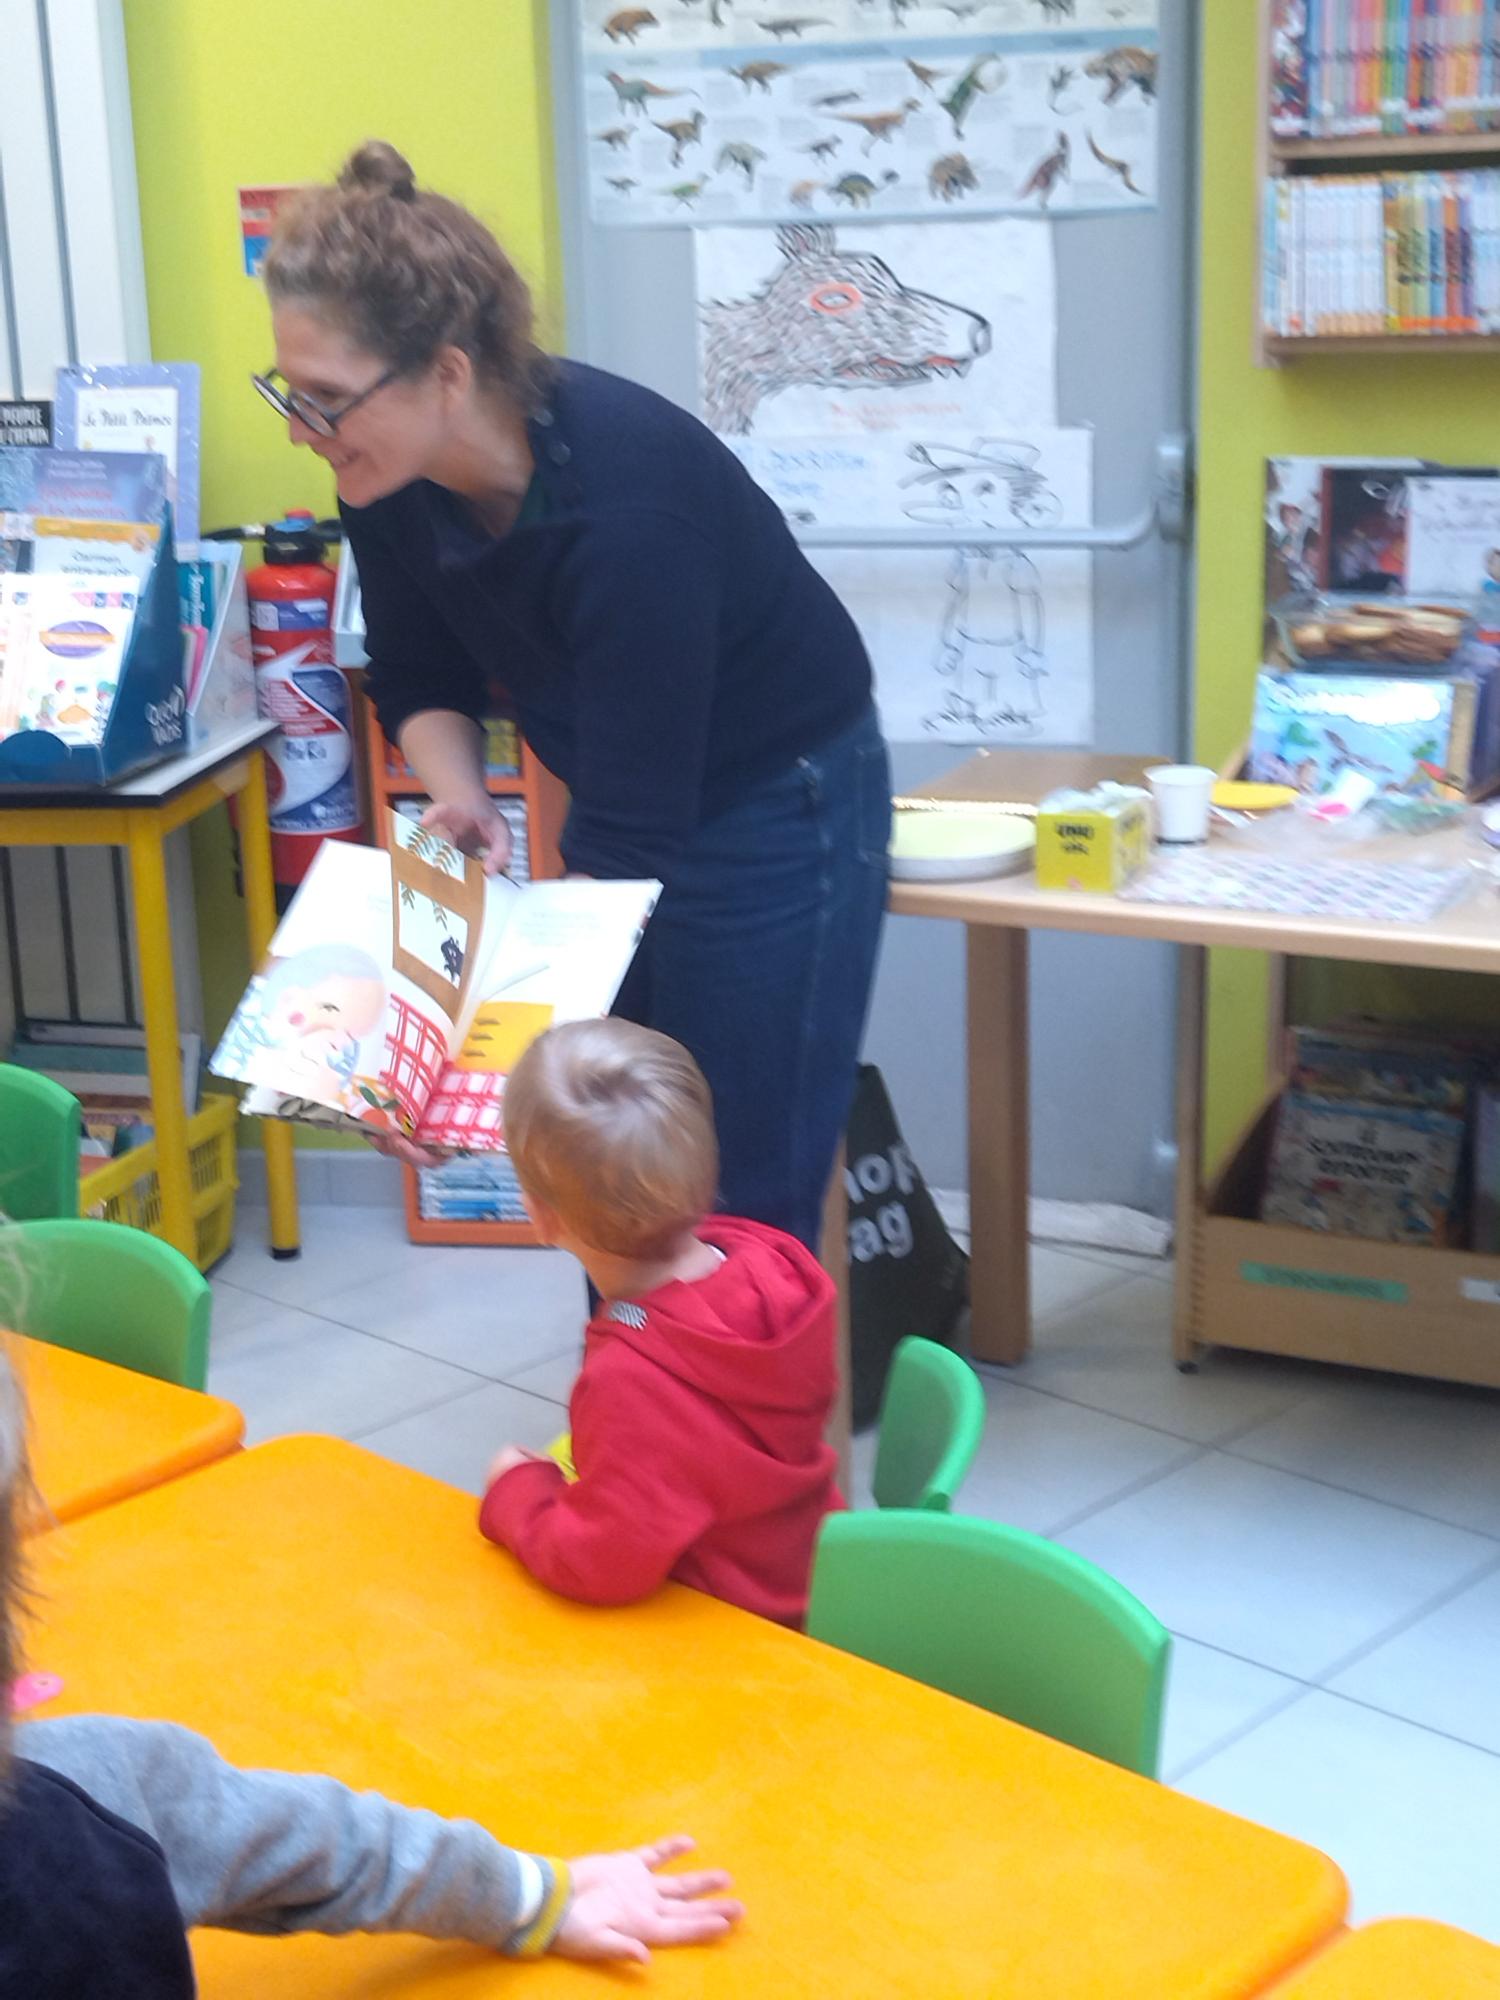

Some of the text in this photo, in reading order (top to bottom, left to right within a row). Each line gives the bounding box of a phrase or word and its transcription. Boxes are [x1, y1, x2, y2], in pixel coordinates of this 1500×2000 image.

[100, 408, 127, 427] Petit
[132, 408, 173, 427] Prince
[847, 1201, 914, 1262] ag
